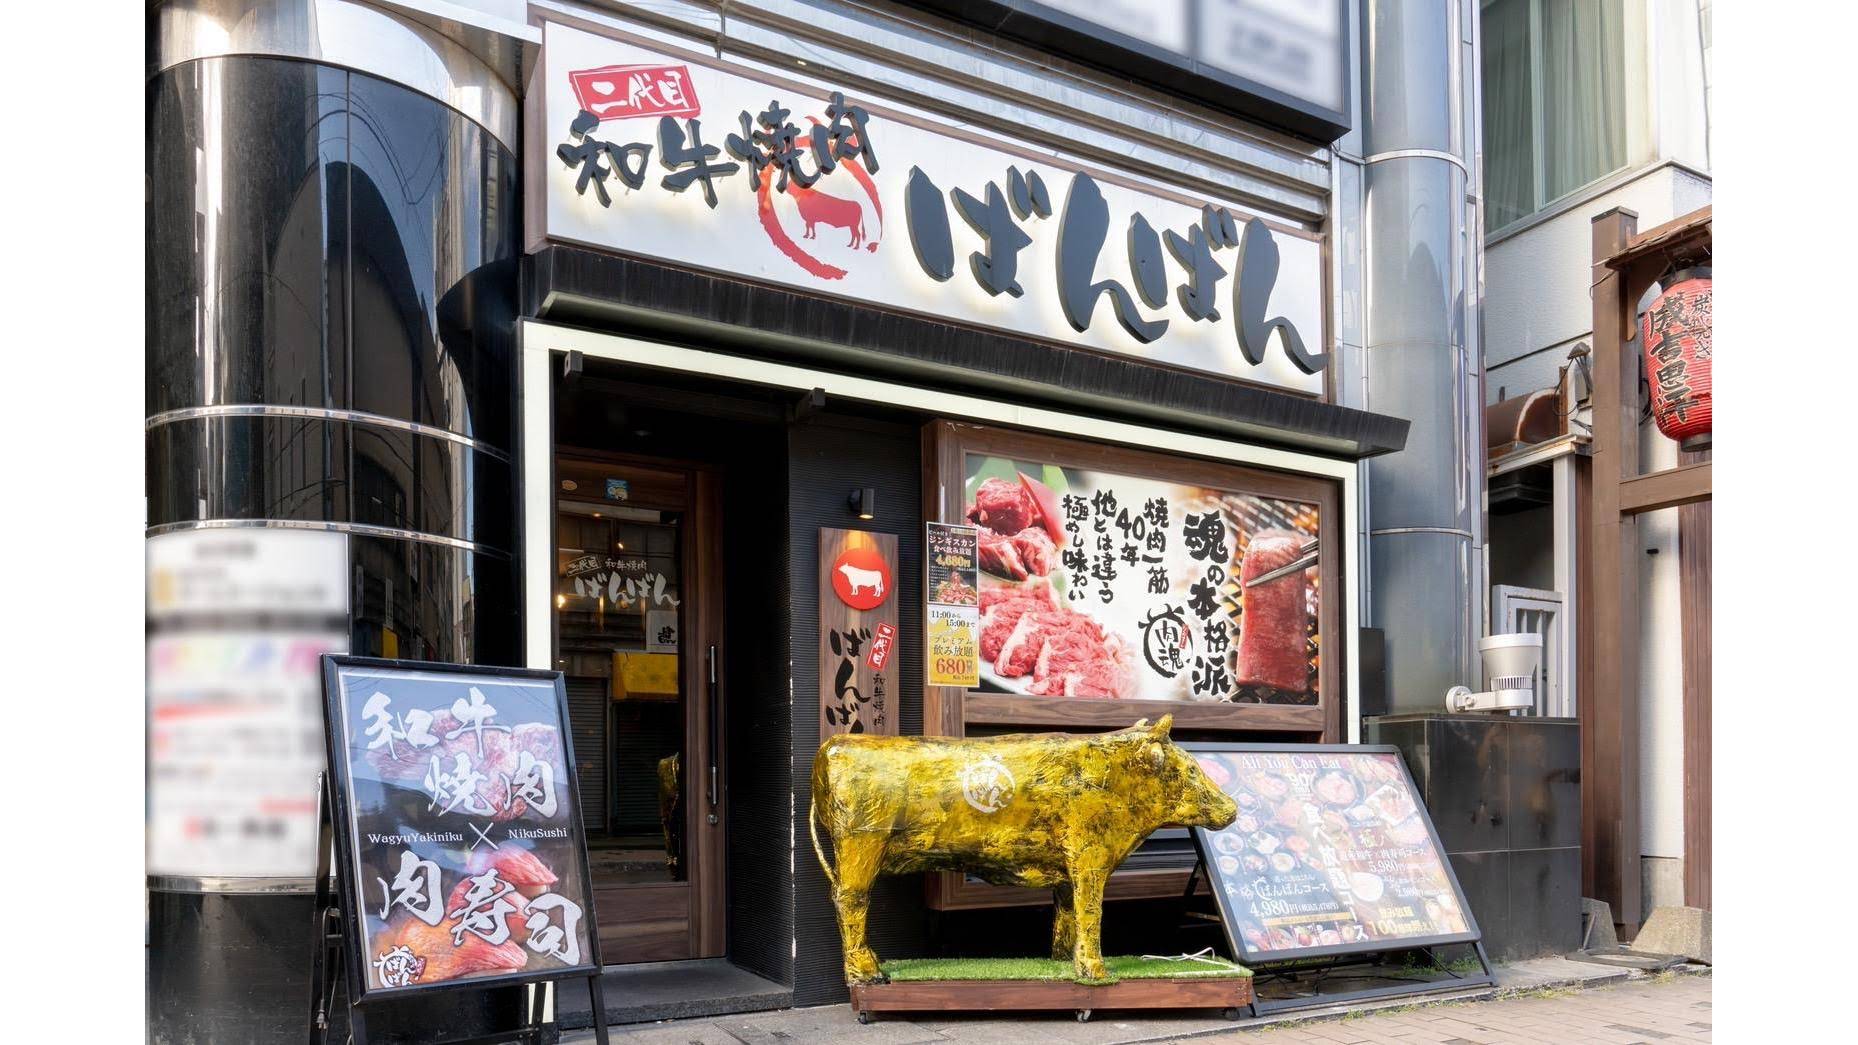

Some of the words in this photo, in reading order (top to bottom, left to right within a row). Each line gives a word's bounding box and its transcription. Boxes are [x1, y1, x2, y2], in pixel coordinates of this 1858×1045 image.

[590, 70, 690, 113] 二代目
[904, 165, 1330, 376] ばんばん
[929, 535, 976, 547] ジンギスカン
[936, 554, 971, 568] 4,680円
[1062, 494, 1089, 601] 極めし味わい
[1090, 489, 1118, 604] 他とは違う
[1115, 507, 1146, 568] 40年
[1142, 497, 1170, 595] 焼肉一筋
[567, 555, 599, 575] 二代目
[574, 571, 681, 606] ばんばん
[945, 619, 976, 628] 15:00まで
[1183, 510, 1232, 696] 魂の本格派
[872, 626, 893, 666] 二代目
[933, 645, 974, 657] 飲み放題
[362, 686, 511, 760] 和牛
[872, 673, 887, 727] 和牛焼肉
[424, 750, 558, 818] 焼肉
[367, 832, 464, 847] WagyuYakiniku
[508, 827, 568, 840] NikuSushi
[377, 850, 583, 966] 肉寿司
